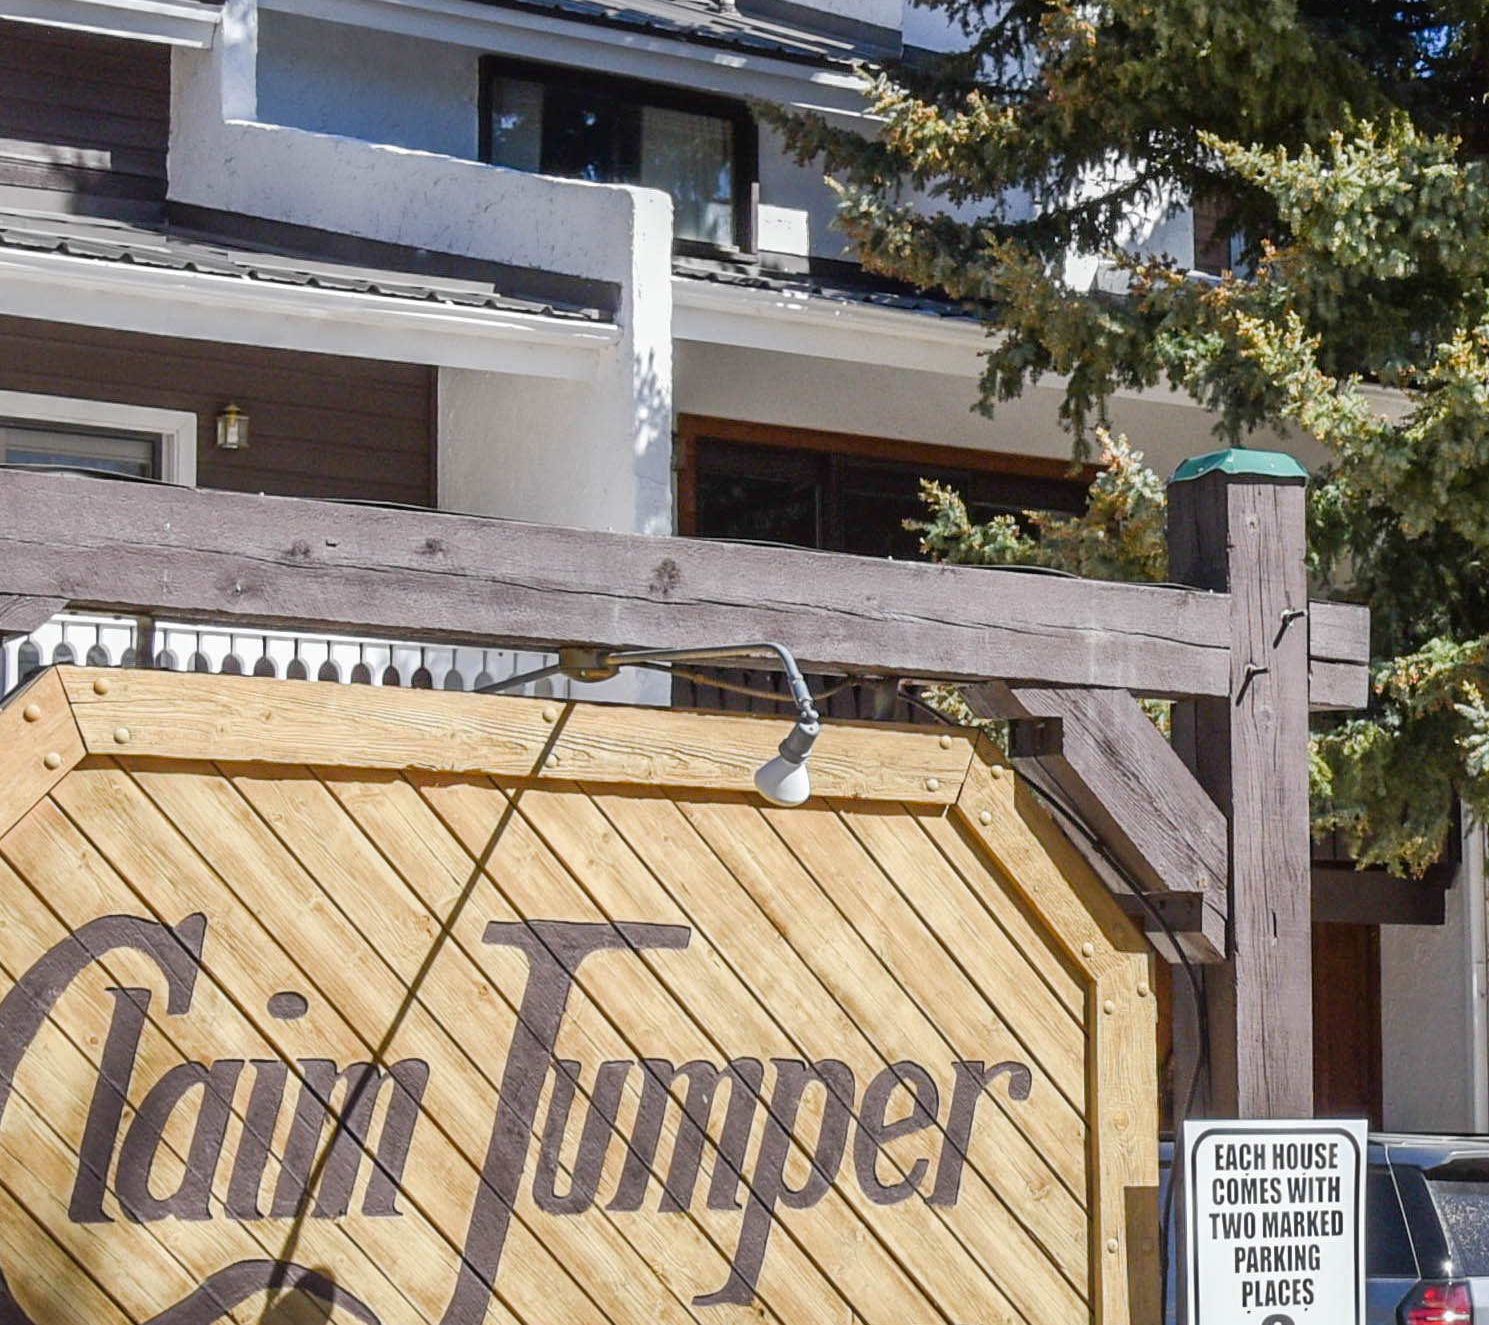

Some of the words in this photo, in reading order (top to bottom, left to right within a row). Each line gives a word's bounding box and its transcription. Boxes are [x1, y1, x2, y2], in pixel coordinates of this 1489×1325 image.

[1215, 1144, 1266, 1171] EACH
[1273, 1143, 1339, 1170] HOUSE
[1212, 1177, 1281, 1205] COMES
[1287, 1176, 1341, 1204] WITH
[1209, 1211, 1255, 1240] TWO
[1263, 1210, 1344, 1238] MARKED
[1234, 1244, 1321, 1273] PARKING
[1242, 1279, 1315, 1308] PLACES
